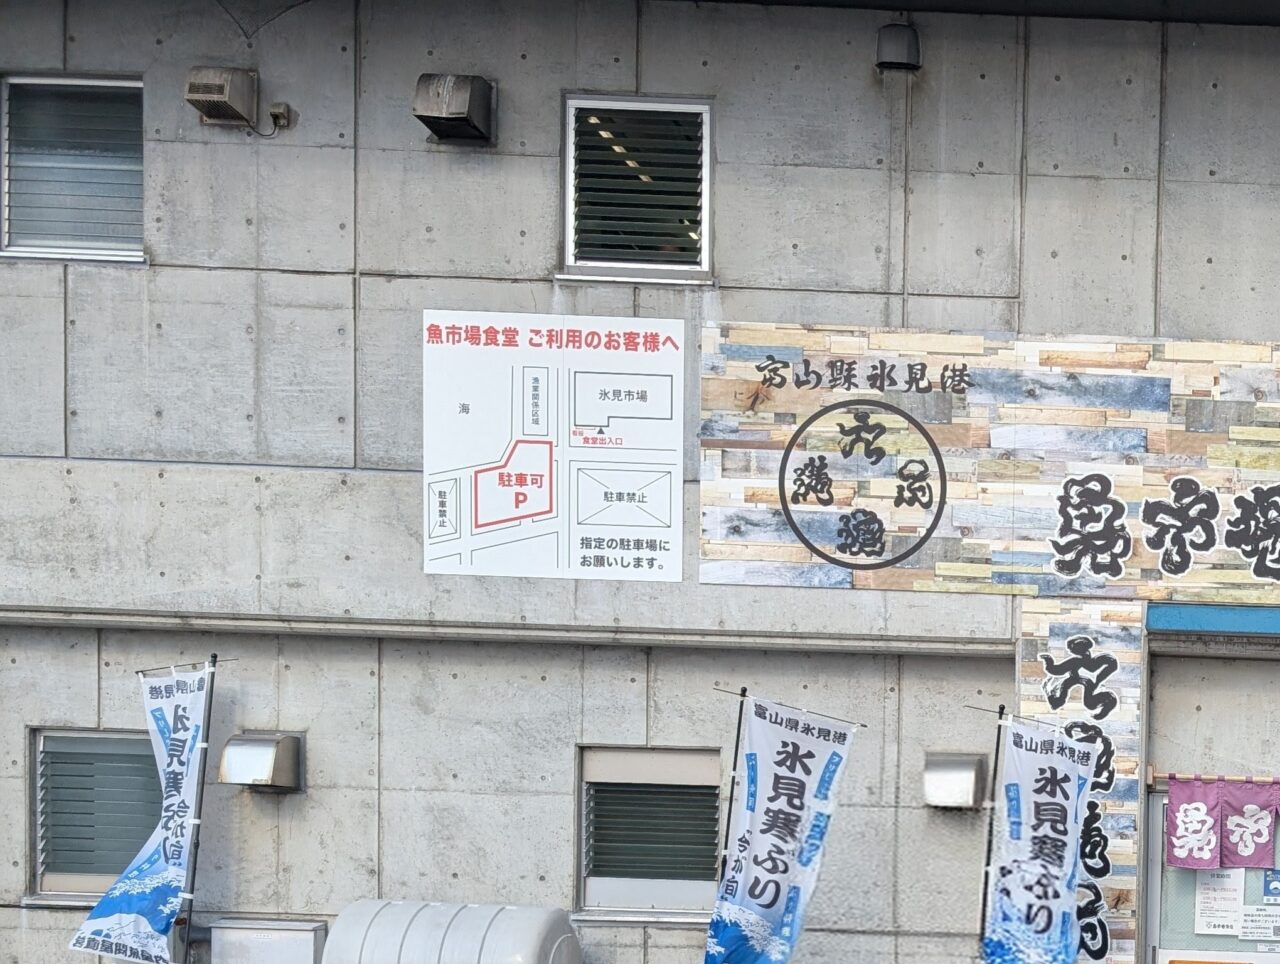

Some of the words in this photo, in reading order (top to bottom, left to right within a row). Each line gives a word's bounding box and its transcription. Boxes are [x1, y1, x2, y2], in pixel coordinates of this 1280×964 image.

[426, 323, 519, 348] 魚市場食堂
[528, 328, 680, 352] ご利用のお客様へ
[598, 388, 648, 403] 氷見市場
[458, 402, 471, 415] 海
[582, 436, 623, 446] 食堂出入口
[498, 472, 545, 489] 駐車可
[514, 492, 528, 509] P
[603, 490, 648, 504] 駐車禁止
[437, 490, 448, 528] 駐車禁止
[580, 536, 671, 552] 指定の駐車場に
[580, 554, 665, 571] お願いします。
[754, 702, 848, 746] 富山県氷見港
[1012, 731, 1091, 767] 富山県氷見港
